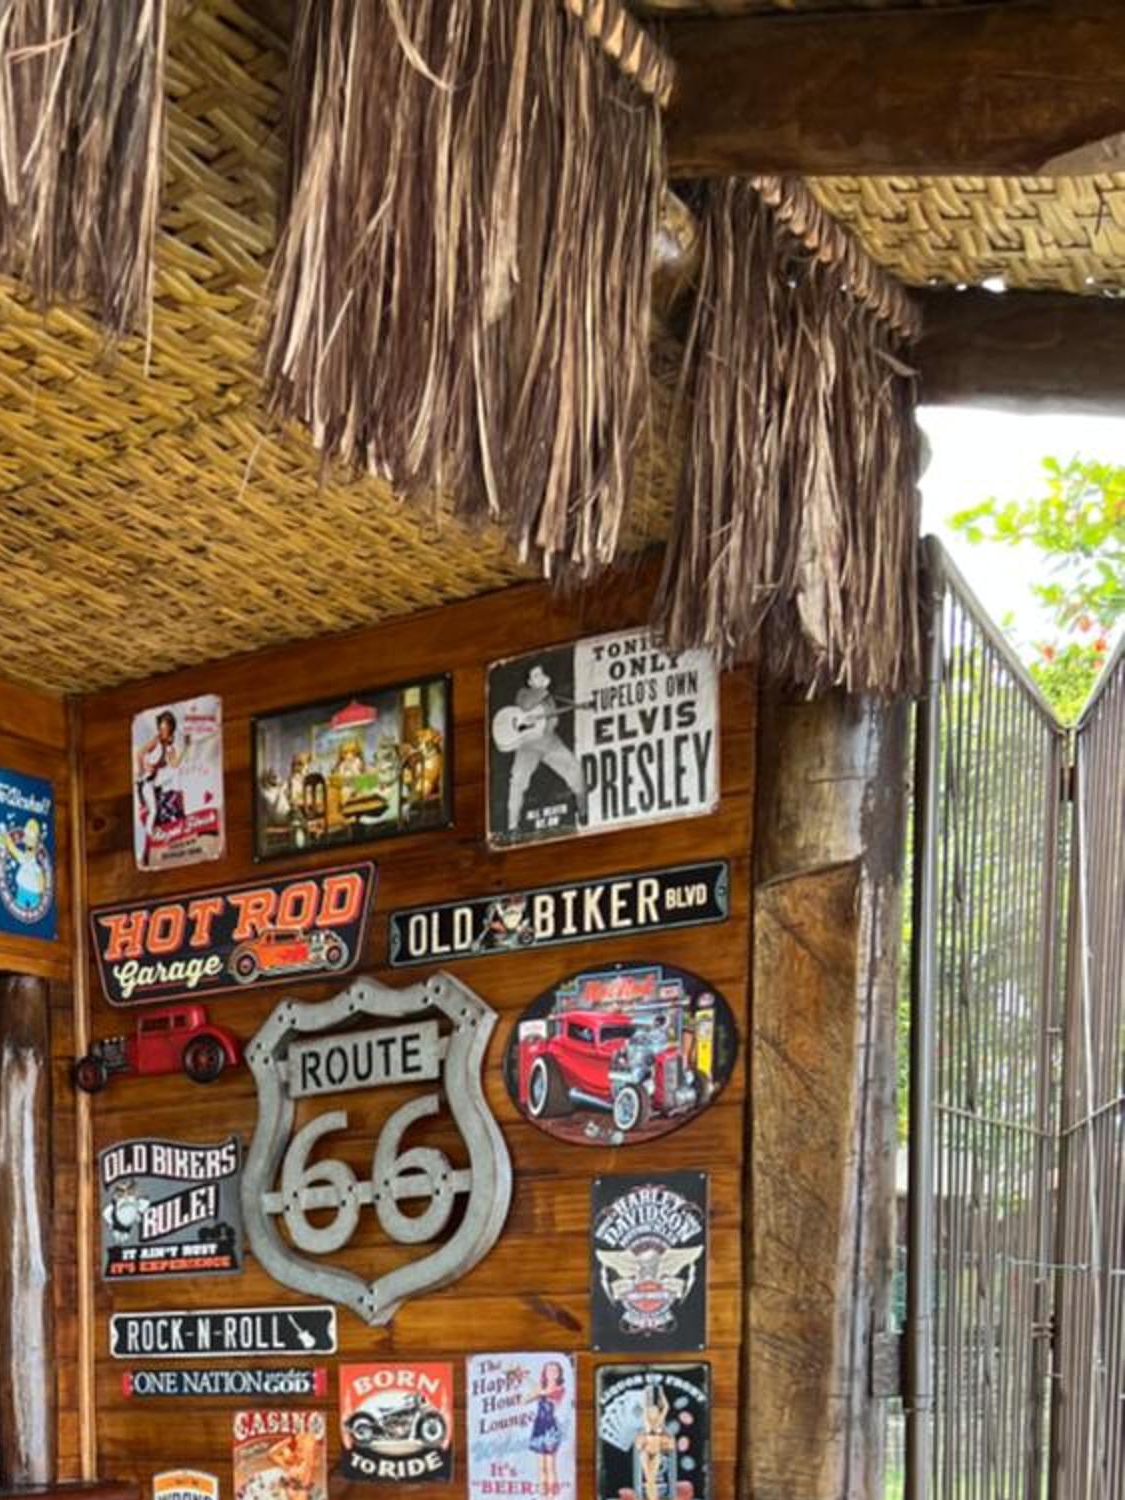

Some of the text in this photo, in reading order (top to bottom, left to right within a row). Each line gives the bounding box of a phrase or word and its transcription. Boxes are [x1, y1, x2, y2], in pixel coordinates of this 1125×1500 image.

[609, 653, 679, 681] ONLY
[592, 670, 699, 712] TUPELO'S OWN
[593, 700, 698, 746] ELVIS
[581, 729, 714, 826] PRESLEY
[98, 872, 364, 962] HOT ROD
[408, 878, 708, 957] OLD BIKER BLVD
[112, 953, 224, 999] Garage
[300, 1033, 423, 1090] ROUTE
[103, 1142, 237, 1185] OLD BIKERS
[281, 1094, 456, 1255] 66
[141, 1185, 217, 1240] RULE!
[126, 1315, 288, 1353] ROCK-N-ROLL
[133, 1370, 265, 1395] ONE NATION
[352, 1369, 442, 1397] BORN
[479, 1359, 503, 1376] The
[232, 1410, 326, 1441] CASINO
[478, 1410, 536, 1436] Lounge
[375, 1452, 445, 1479] RIDE
